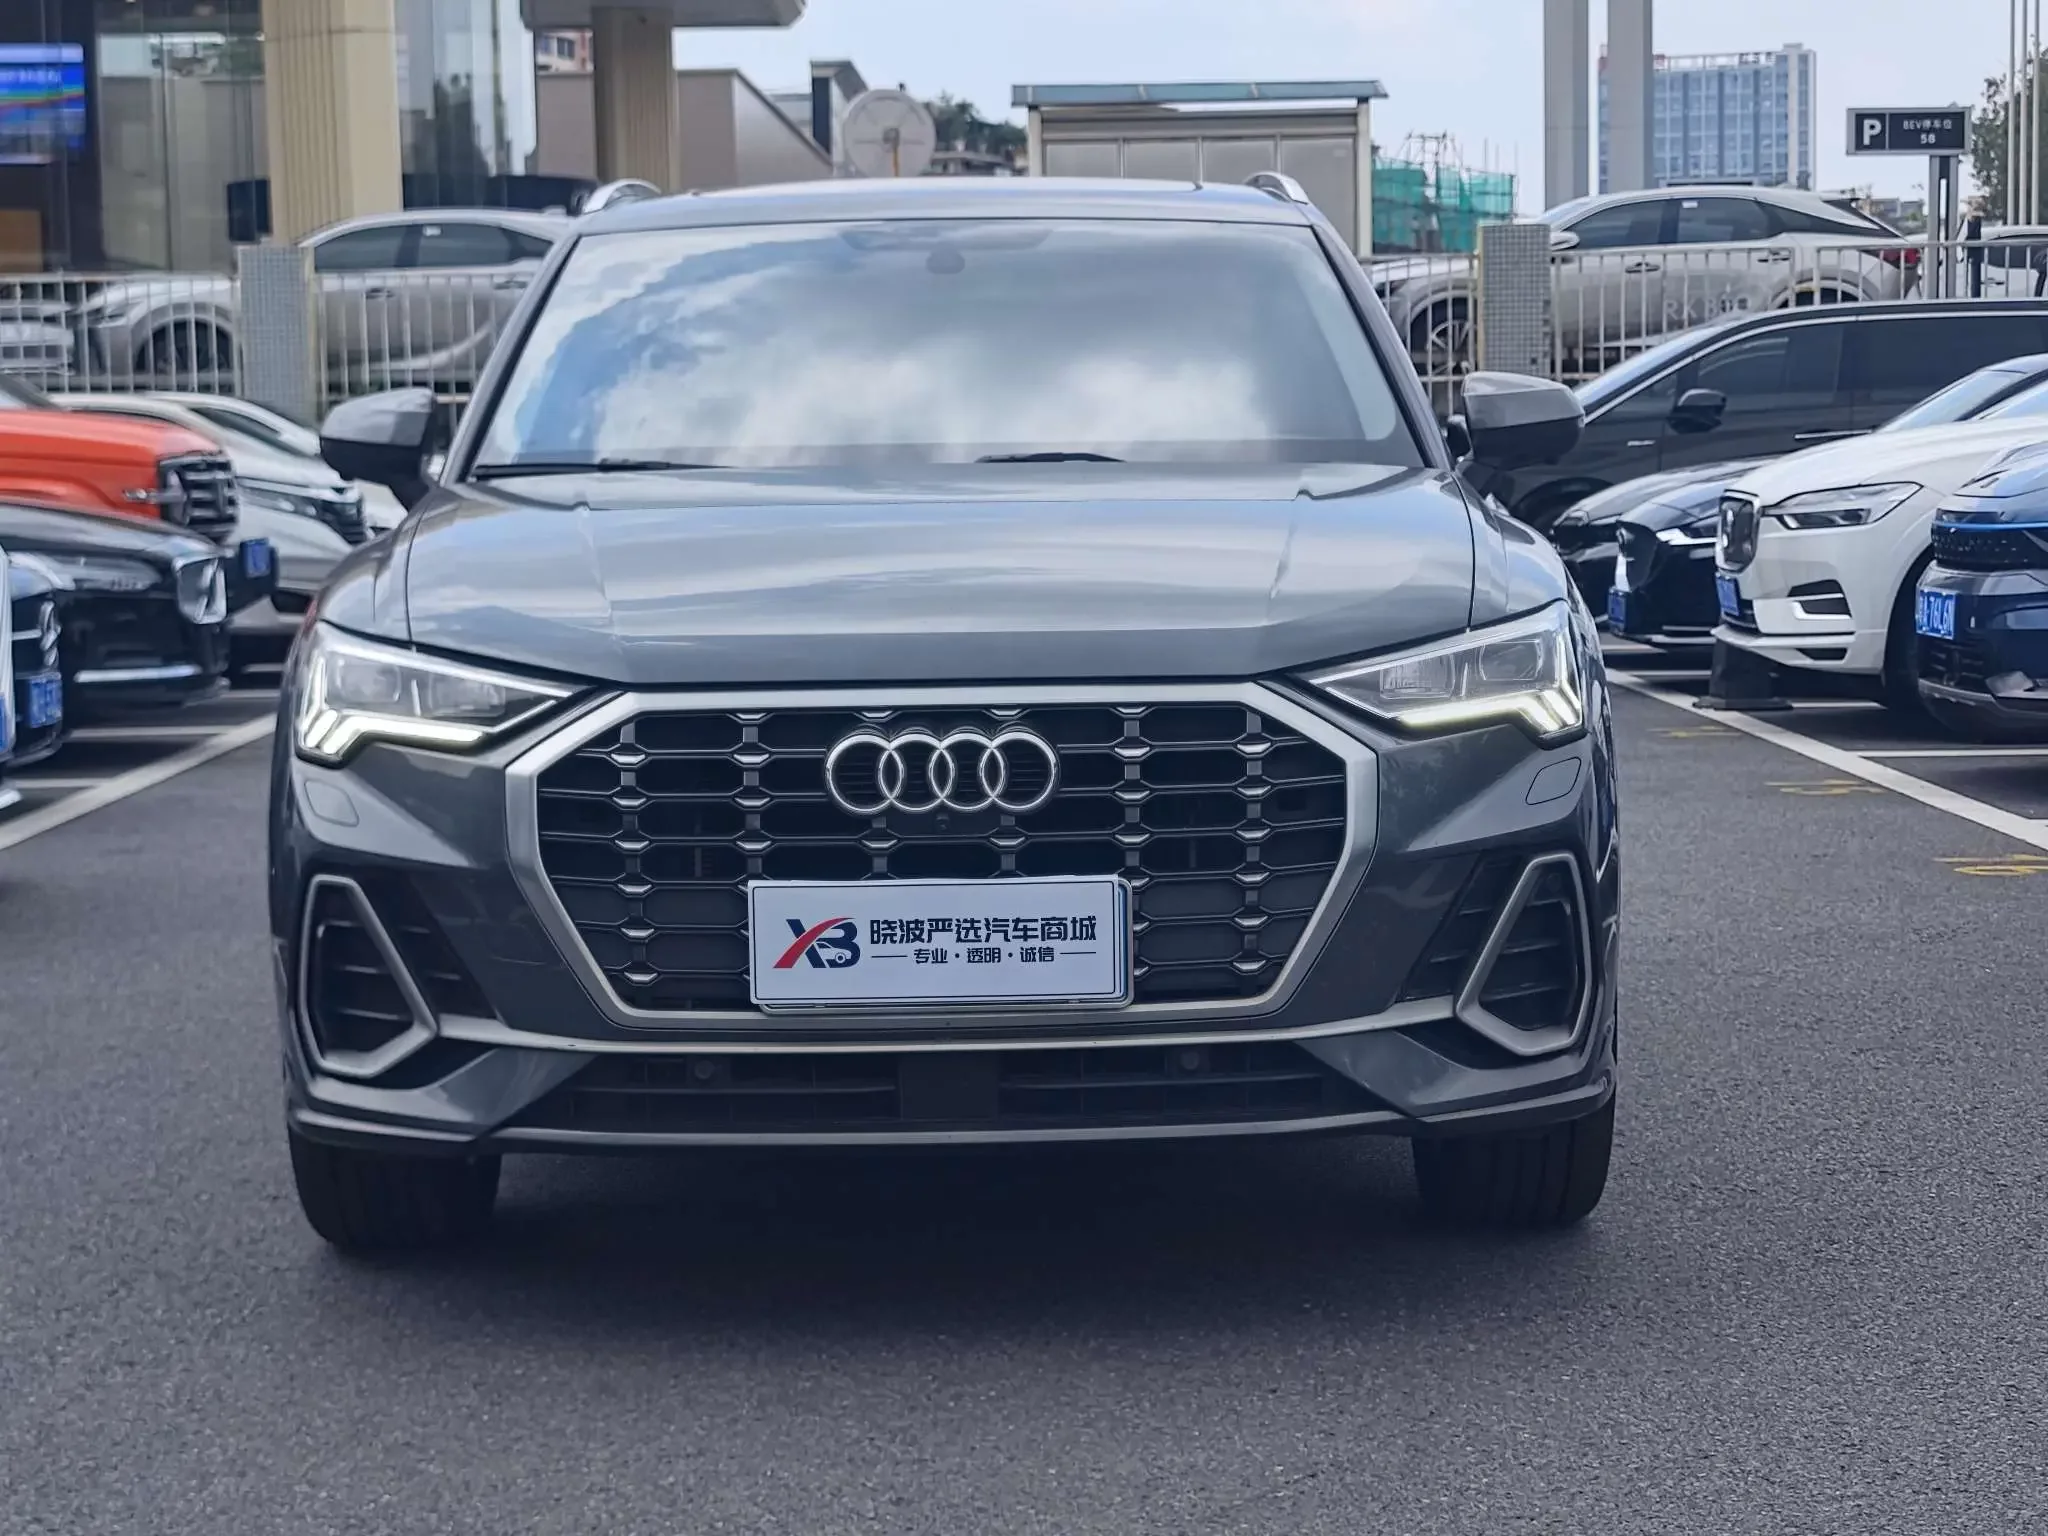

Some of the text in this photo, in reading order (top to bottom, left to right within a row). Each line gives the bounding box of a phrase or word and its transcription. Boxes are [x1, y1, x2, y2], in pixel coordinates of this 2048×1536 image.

[1863, 119, 1882, 146] P
[870, 916, 1097, 944] 晓波严选汽车商城
